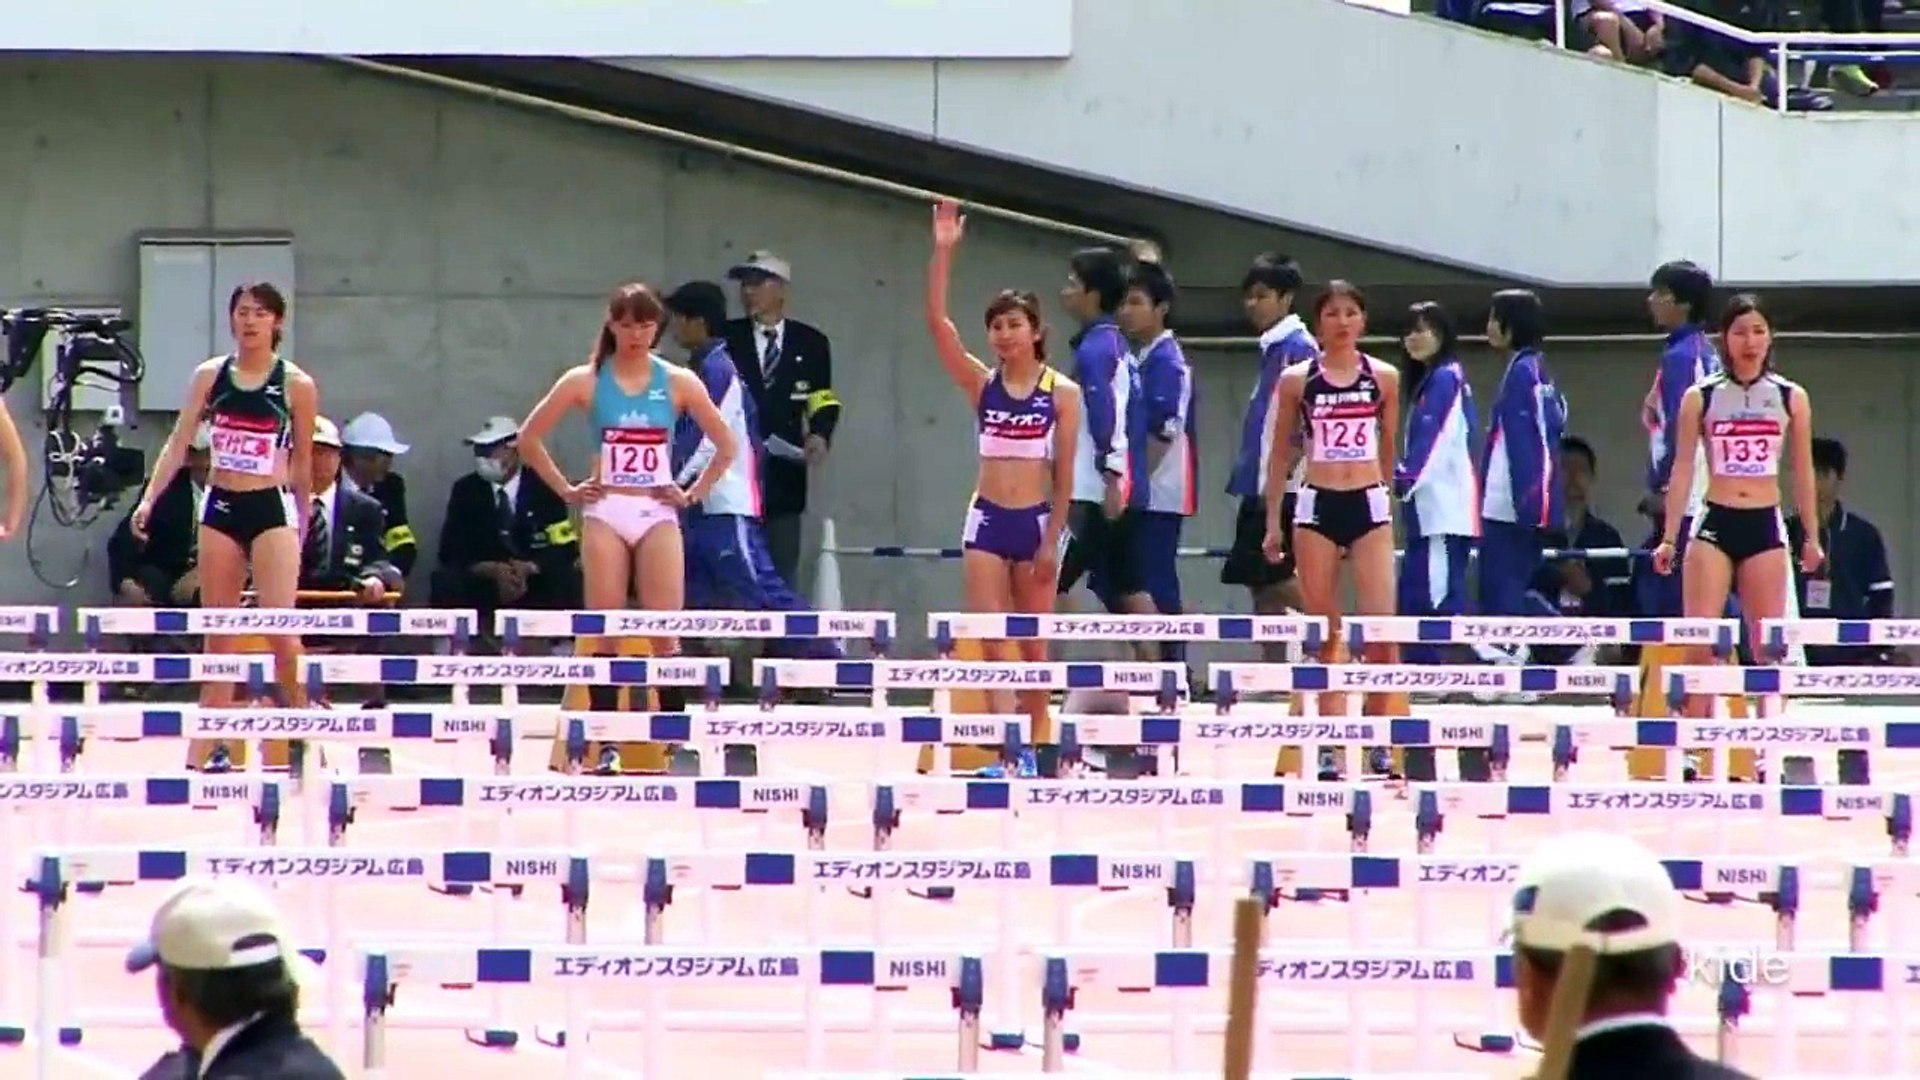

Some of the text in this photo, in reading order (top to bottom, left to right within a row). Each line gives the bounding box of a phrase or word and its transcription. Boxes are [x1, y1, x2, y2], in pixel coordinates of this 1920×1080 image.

[984, 409, 1047, 425] エディオン
[1321, 422, 1366, 447] 126
[1722, 438, 1768, 462] 133
[610, 446, 659, 473] 120
[203, 615, 354, 628] エディオンスタジアム広島
[411, 618, 447, 629] NISHI
[619, 618, 771, 631] エディオンスタジアム広島
[829, 620, 864, 631] NISHI
[1054, 621, 1205, 635] エディオンスタジアム広島
[1262, 625, 1297, 635] NISHI
[1464, 625, 1616, 638] エディオンスタジアム広島
[1674, 627, 1709, 637] NISHI
[202, 664, 240, 675] NISHI
[432, 664, 595, 678] エディオンスタジアム広島
[657, 668, 696, 679] NISHI
[888, 668, 1052, 683] エディオンスタジアム広島
[1114, 672, 1153, 683] NISHI
[1343, 672, 1505, 686] エディオンスタジアム広島
[1568, 675, 1606, 686] NISHI
[198, 717, 376, 732] エディオンスタジアム広島
[444, 720, 486, 732] NISHI
[707, 721, 885, 737] エディオンスタジアム広島
[954, 725, 995, 737] NISHI
[1197, 724, 1374, 739] エディオンスタジアム広島
[1442, 727, 1483, 739] NISHI
[1693, 727, 1870, 742] エディオンスタジアム広島
[203, 785, 248, 799] NISHI
[480, 786, 677, 801] エディオンスタジアム広島
[753, 788, 799, 802] NISHI
[1028, 788, 1223, 805] エディオンスタジアム広島
[1298, 792, 1343, 806] NISHI
[1568, 793, 1764, 810] エディオンスタジアム広島
[1837, 797, 1882, 809] NISHI
[207, 858, 424, 876] エディオンスタジアム広島
[506, 861, 556, 875] NISHI
[814, 861, 1031, 879] エディオンスタジアム広島
[1112, 864, 1161, 879] NISHI
[1717, 869, 1767, 884] NISHI
[555, 957, 799, 977] エディオンスタジアム広島
[890, 961, 946, 977] NISHI
[1256, 959, 1474, 980] ディオンスタジアム広島
